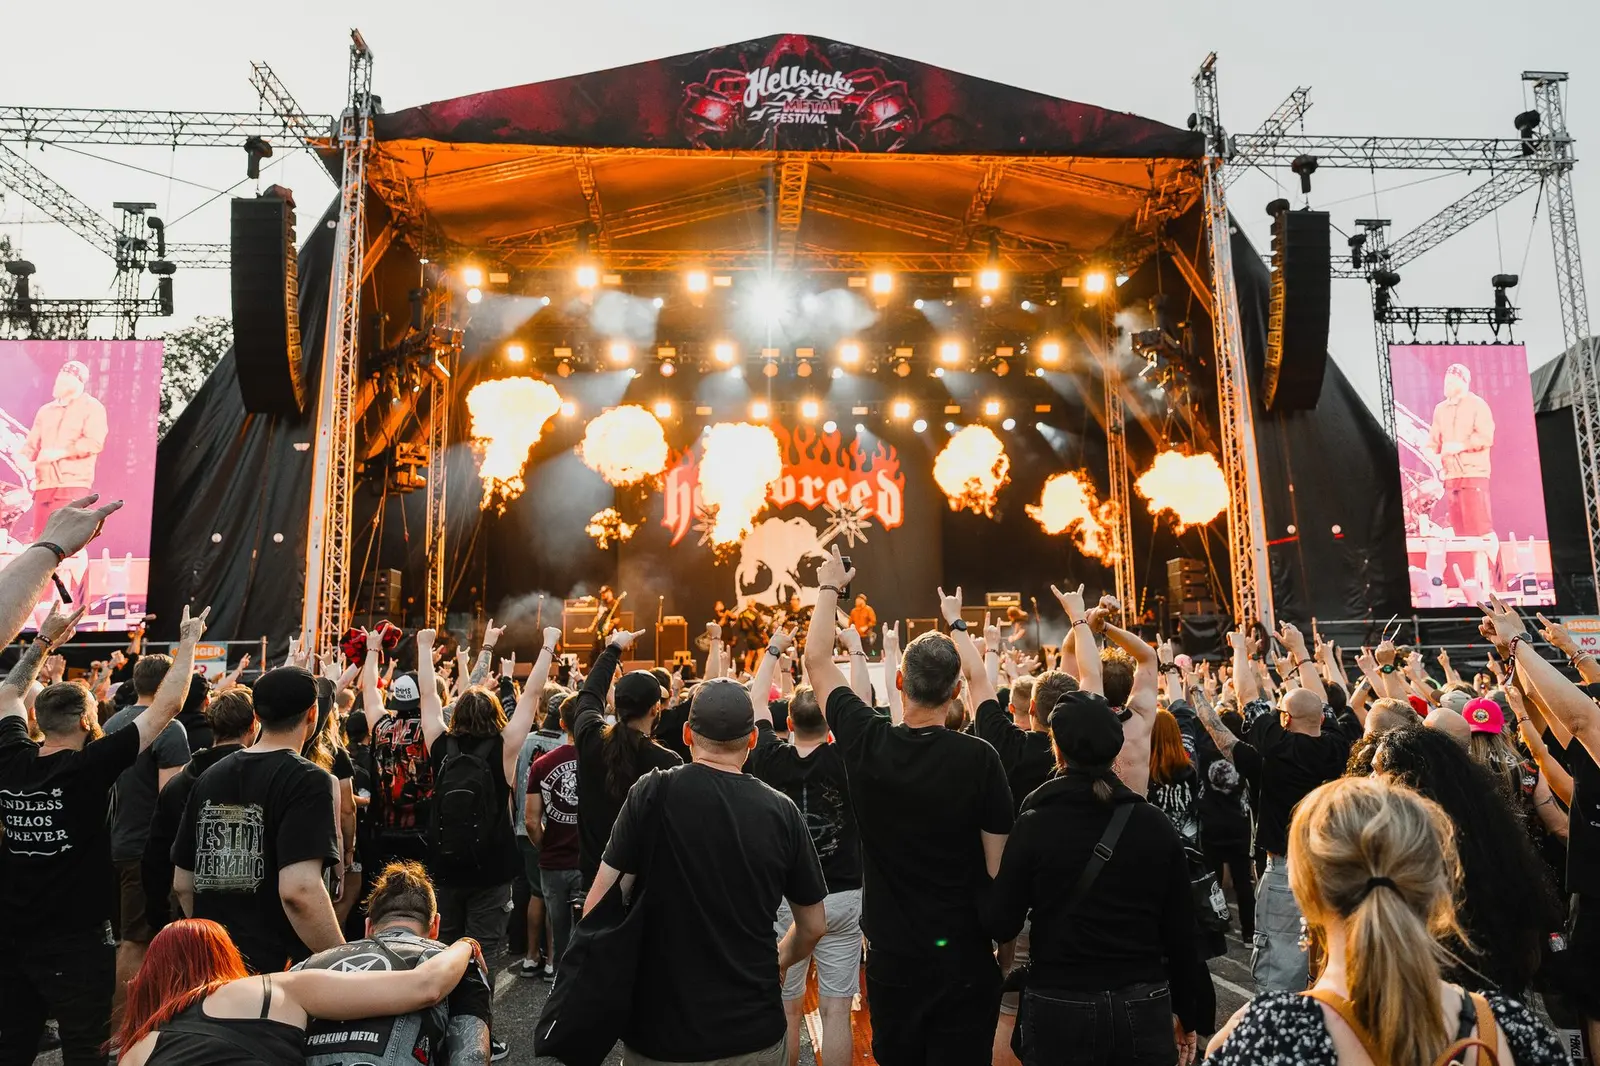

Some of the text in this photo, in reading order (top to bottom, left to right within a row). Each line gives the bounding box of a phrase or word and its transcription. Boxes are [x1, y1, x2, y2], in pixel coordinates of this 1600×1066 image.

[743, 65, 855, 108] Hellsinki
[783, 100, 842, 115] METAL
[772, 112, 828, 125] FESTIVAL
[1581, 637, 1597, 646] NO
[550, 761, 577, 780] THE GHOS
[6, 814, 53, 827] CHAOS
[6, 829, 69, 842] OREVER
[307, 1030, 379, 1046] FUCKING METAL
